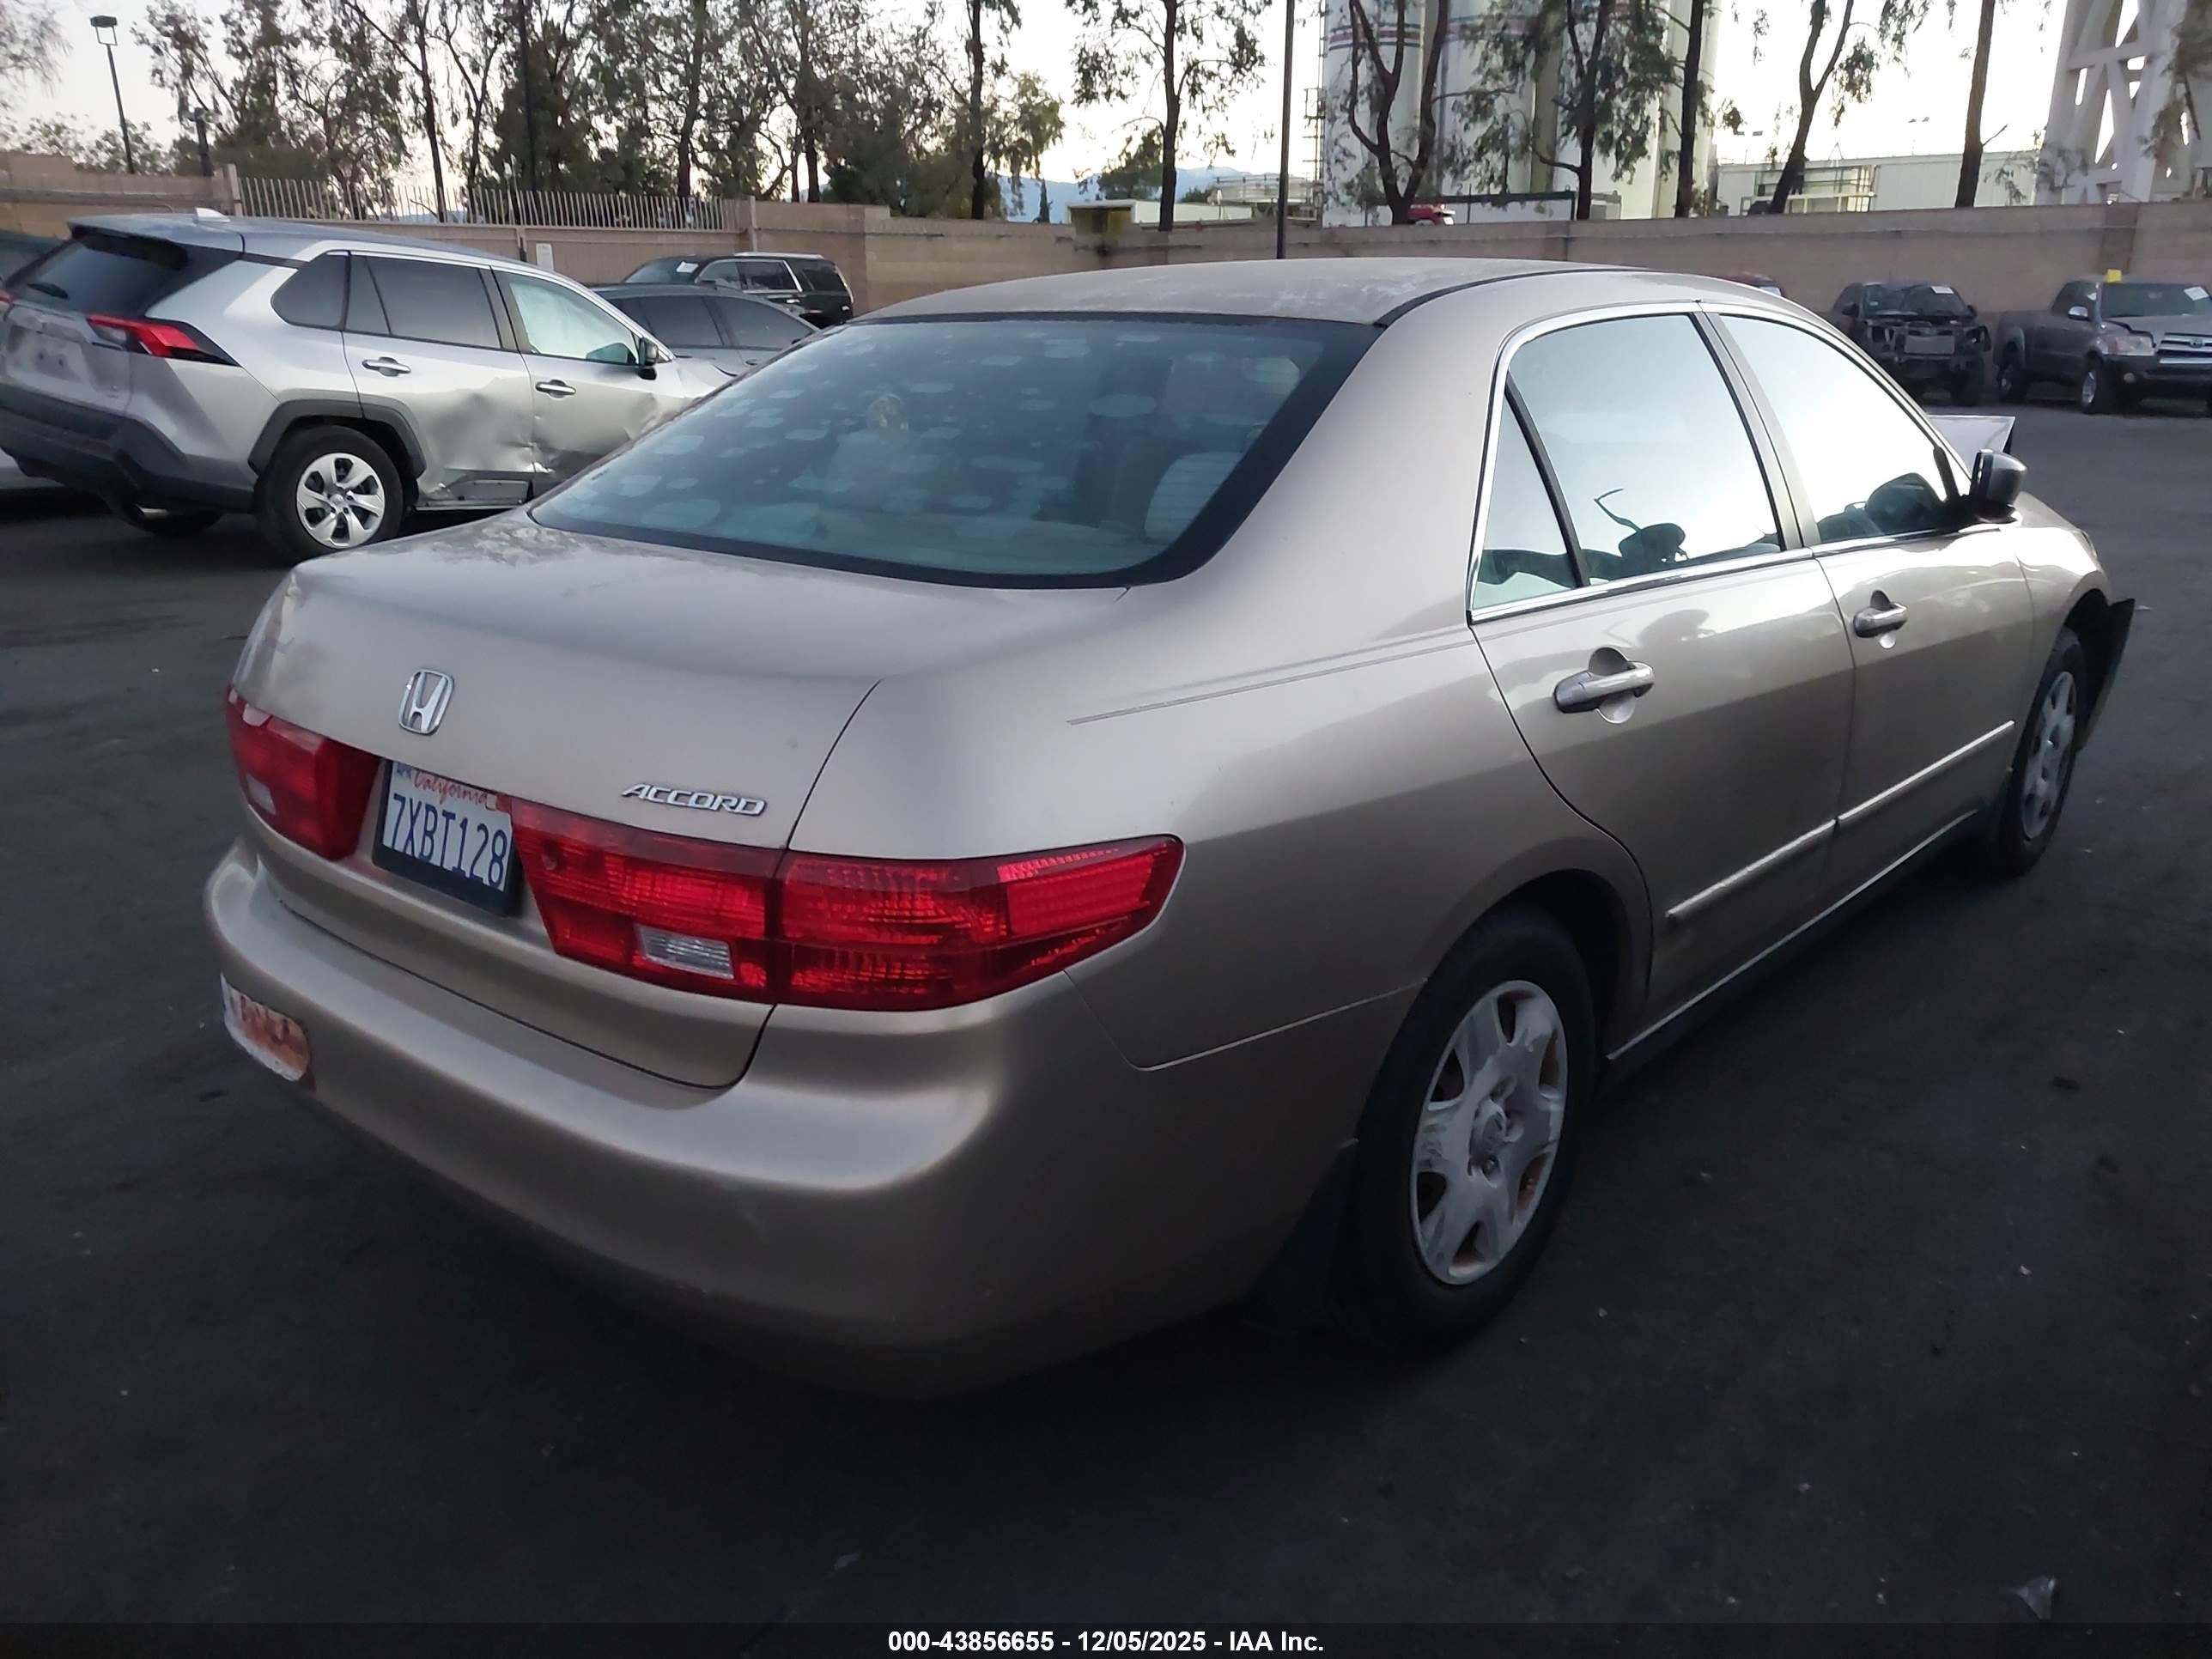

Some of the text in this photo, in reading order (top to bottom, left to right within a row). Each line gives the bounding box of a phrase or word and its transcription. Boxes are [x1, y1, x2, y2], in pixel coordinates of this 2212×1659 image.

[413, 770, 489, 805] California
[622, 783, 766, 816] ACCORD
[392, 792, 508, 888] 7XBT128
